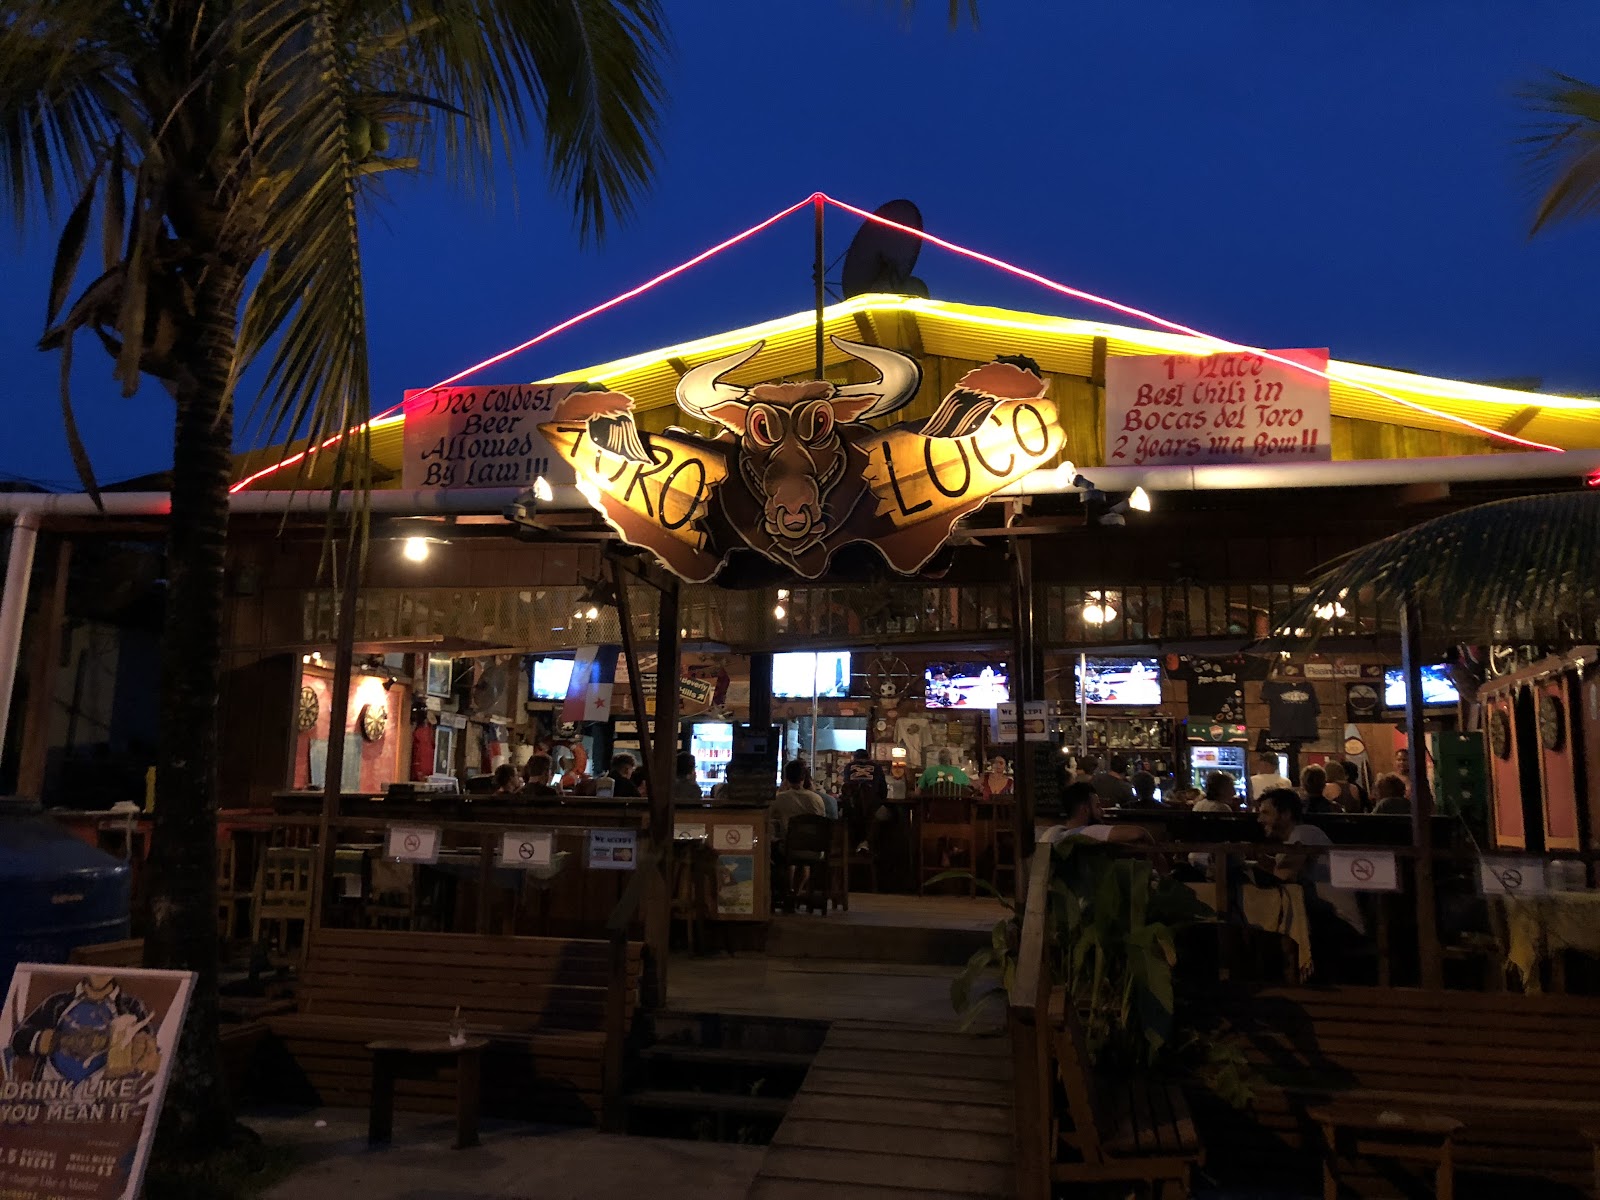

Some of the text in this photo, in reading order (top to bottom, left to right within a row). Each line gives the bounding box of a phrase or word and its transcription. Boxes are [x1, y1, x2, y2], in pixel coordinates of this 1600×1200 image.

[426, 388, 476, 414] The
[1134, 379, 1284, 407] Best Chili in
[458, 414, 525, 435] Beer
[1122, 404, 1304, 431] Bocas del Toro
[421, 432, 532, 460] Allowed
[1112, 435, 1128, 458] 2
[1134, 433, 1200, 465] Years
[421, 463, 455, 487] By
[681, 677, 708, 692] Beverly
[4, 1078, 134, 1100] DRINK LIKE
[0, 1102, 131, 1121] YOU MEAN IT
